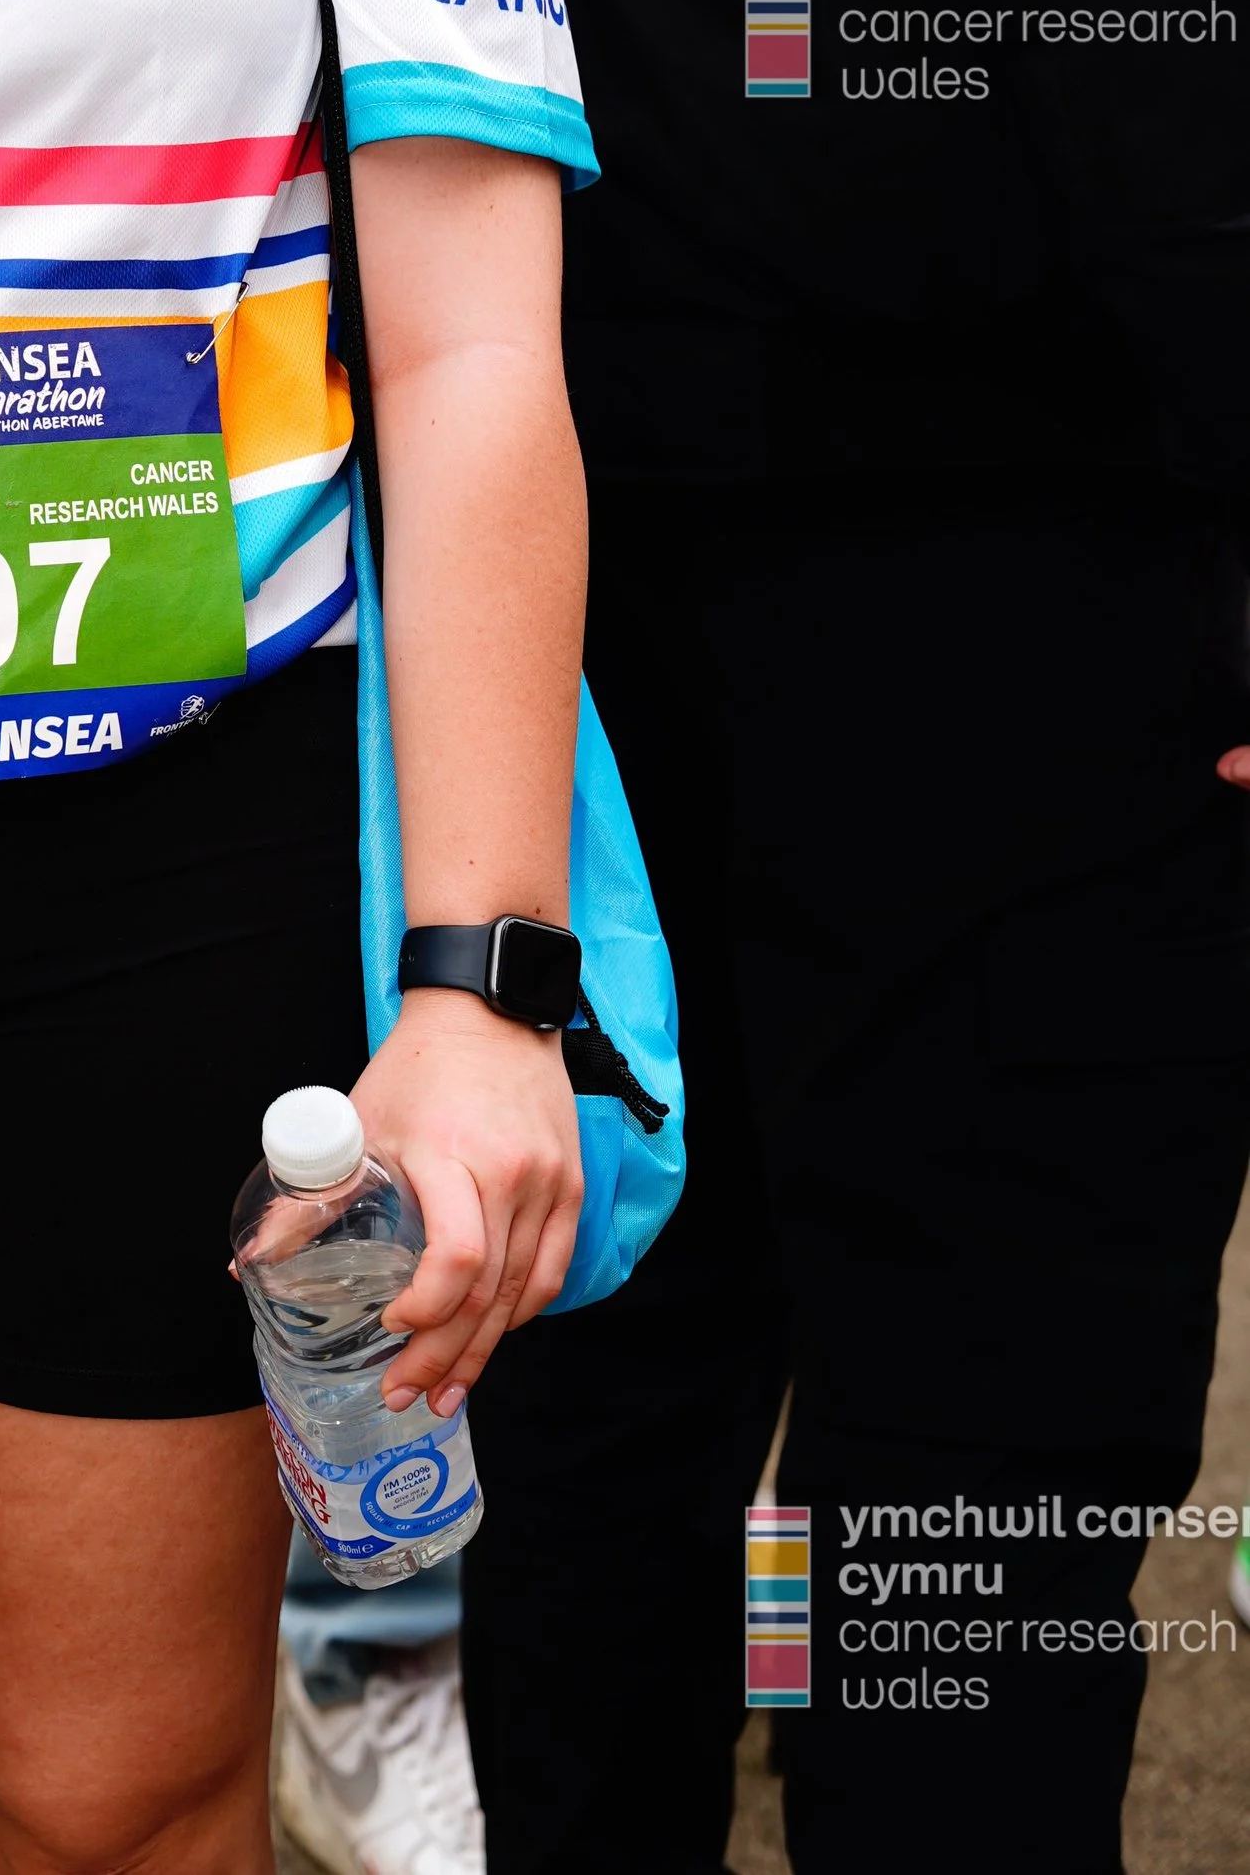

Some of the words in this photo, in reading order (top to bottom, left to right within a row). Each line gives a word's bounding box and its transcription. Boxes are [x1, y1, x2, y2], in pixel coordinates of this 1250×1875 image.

[33, 413, 104, 430] ABERTAWE
[130, 459, 215, 486] CANCER
[29, 496, 145, 525] RESEARCH
[148, 491, 220, 517] WALES
[383, 1479, 400, 1492] I'M
[402, 1464, 431, 1483] 100%
[384, 1473, 432, 1499] RECYCLABLE
[393, 1496, 416, 1510] second
[394, 1493, 410, 1504] Give
[365, 1501, 384, 1523] SQUASH
[427, 1509, 458, 1527] RECYCLE
[337, 1542, 361, 1554] 500ml
